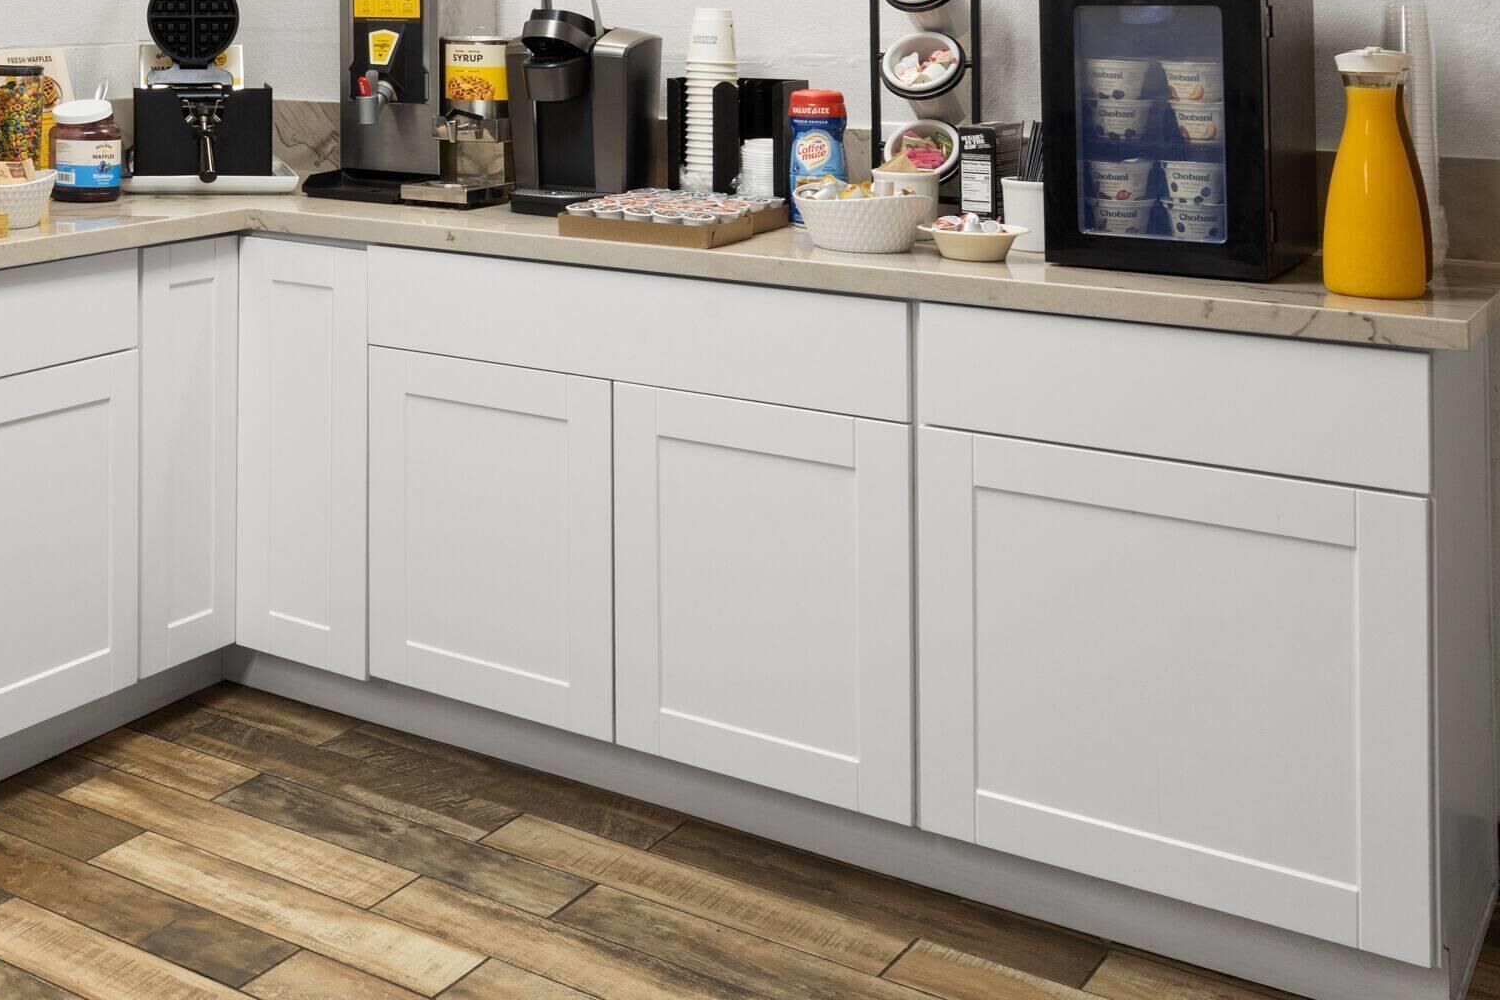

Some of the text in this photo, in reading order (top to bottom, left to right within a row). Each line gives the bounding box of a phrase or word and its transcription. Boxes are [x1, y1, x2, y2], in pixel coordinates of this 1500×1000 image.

[27, 55, 53, 63] WAFFLES
[452, 54, 484, 62] SYRUP
[1099, 109, 1136, 118] Chobani
[1178, 112, 1213, 121] Chobani
[797, 143, 826, 155] Coffee
[802, 150, 827, 161] mate
[1172, 171, 1211, 181] Chobani
[1100, 208, 1138, 218] Chobani
[1179, 212, 1219, 222] Chobani
